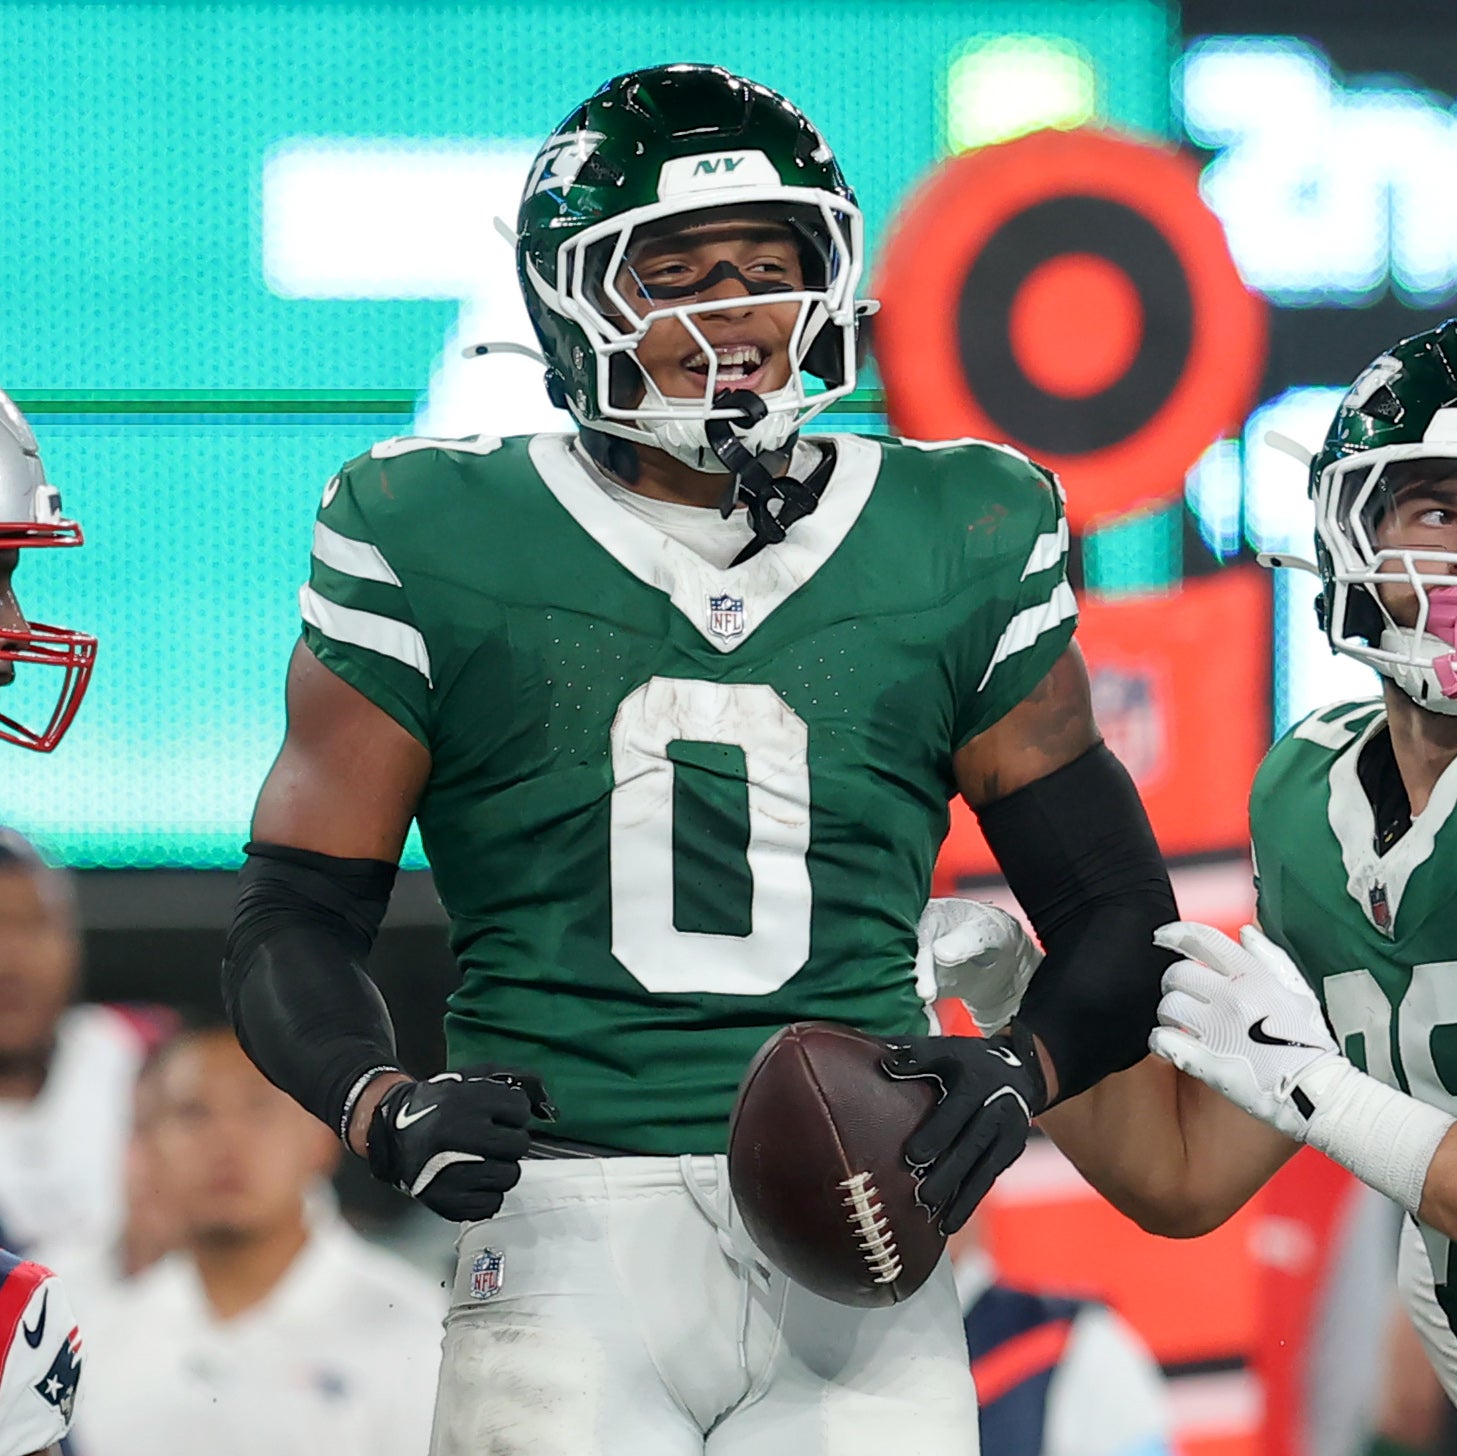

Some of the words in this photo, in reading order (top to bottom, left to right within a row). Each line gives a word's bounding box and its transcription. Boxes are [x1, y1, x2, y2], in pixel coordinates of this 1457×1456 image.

[693, 157, 745, 177] NY
[713, 612, 741, 633] NFL
[611, 676, 811, 995] 0
[473, 1271, 496, 1292] NFL
